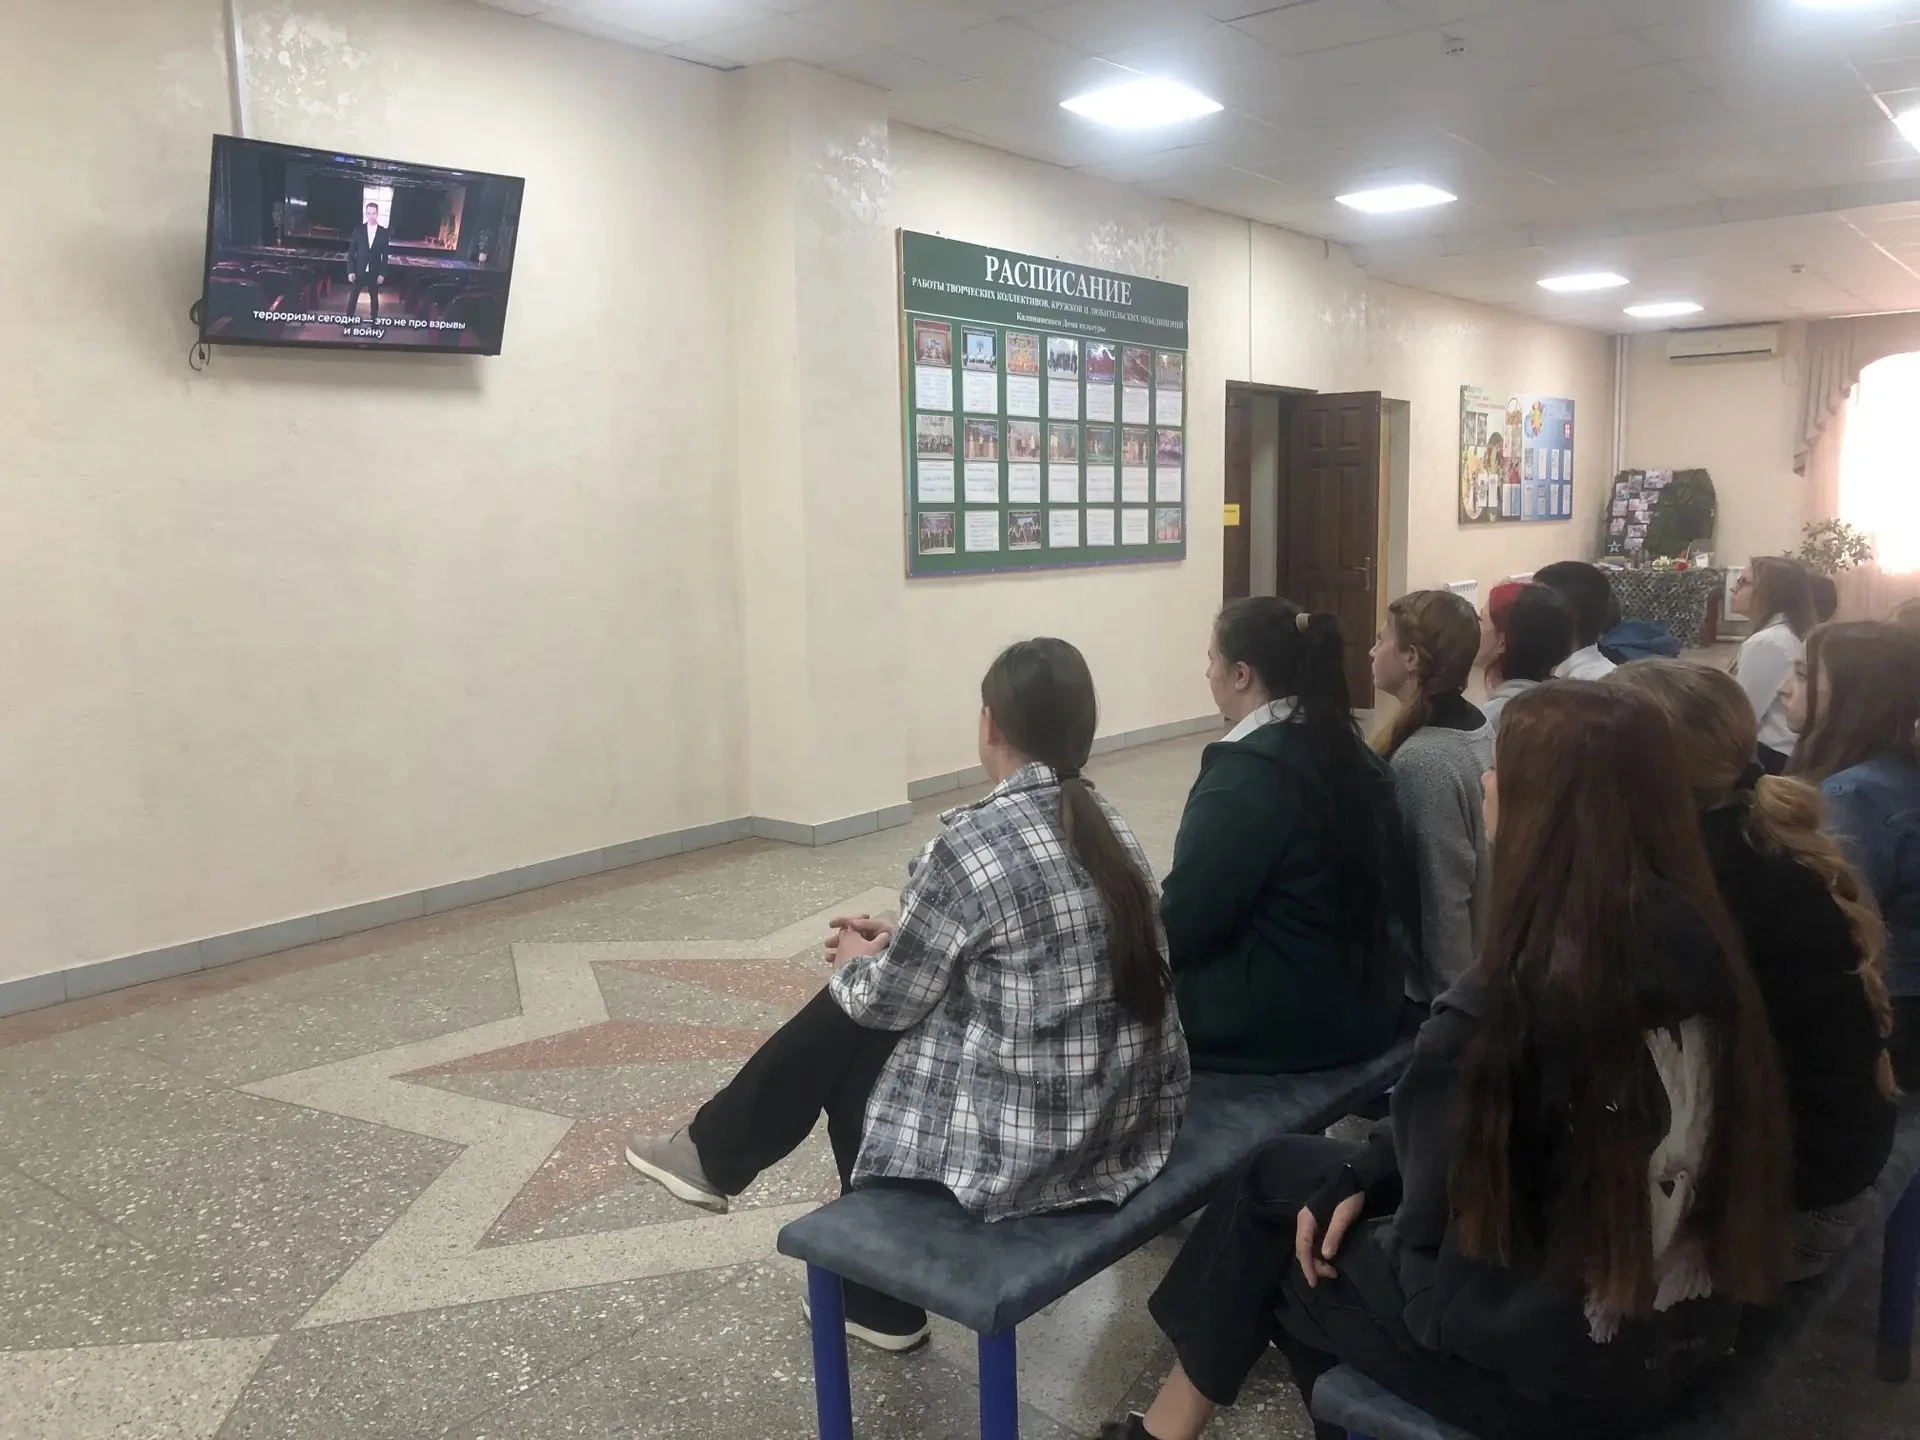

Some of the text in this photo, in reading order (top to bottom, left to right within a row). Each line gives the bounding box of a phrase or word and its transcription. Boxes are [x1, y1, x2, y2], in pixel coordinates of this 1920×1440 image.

[984, 254, 1133, 306] РАСПИСАНИЕ
[911, 276, 945, 292] РАБОТЫ
[945, 282, 996, 300] ТВОРЧЕСКИХ
[1051, 300, 1083, 314] КРУЖКОВ
[1083, 305, 1089, 317] И
[1089, 307, 1140, 323] ЛЮБИТЕЛЬСКИХ
[252, 309, 315, 322] терроризм
[317, 313, 361, 325] сегодня
[375, 316, 392, 327] это
[394, 317, 407, 327] не
[408, 318, 428, 330] про
[429, 319, 466, 331] взрывы
[1079, 323, 1107, 334] культуры
[343, 325, 385, 338] и войну
